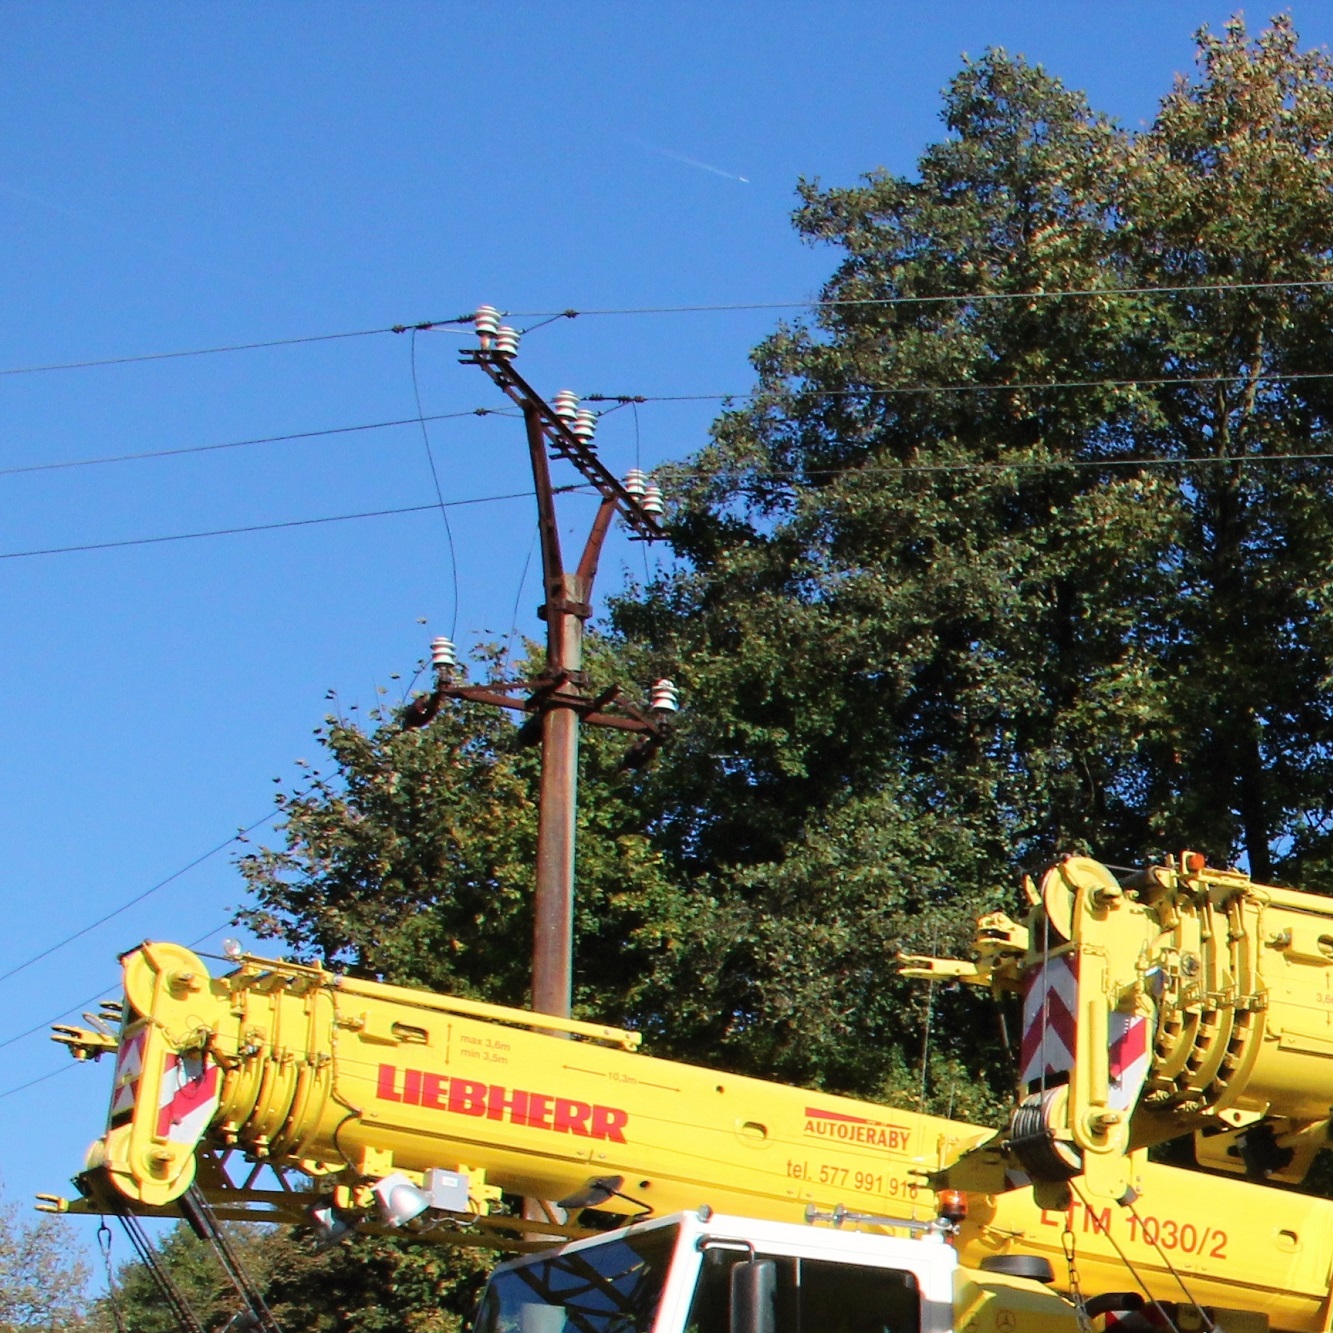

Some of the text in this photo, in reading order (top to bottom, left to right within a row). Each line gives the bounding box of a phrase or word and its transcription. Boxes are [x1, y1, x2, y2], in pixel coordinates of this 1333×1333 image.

[460, 1033, 511, 1052] max 3,6m
[460, 1047, 509, 1065] min 3,5m
[607, 1071, 638, 1085] 10,3m
[376, 1063, 629, 1145] LIEBHERR
[804, 1120, 911, 1151] AUTOJERABY
[787, 1160, 812, 1181] tel.
[819, 1165, 849, 1186] 577
[854, 1171, 882, 1193] 991
[1126, 1215, 1228, 1260] 1030/2
